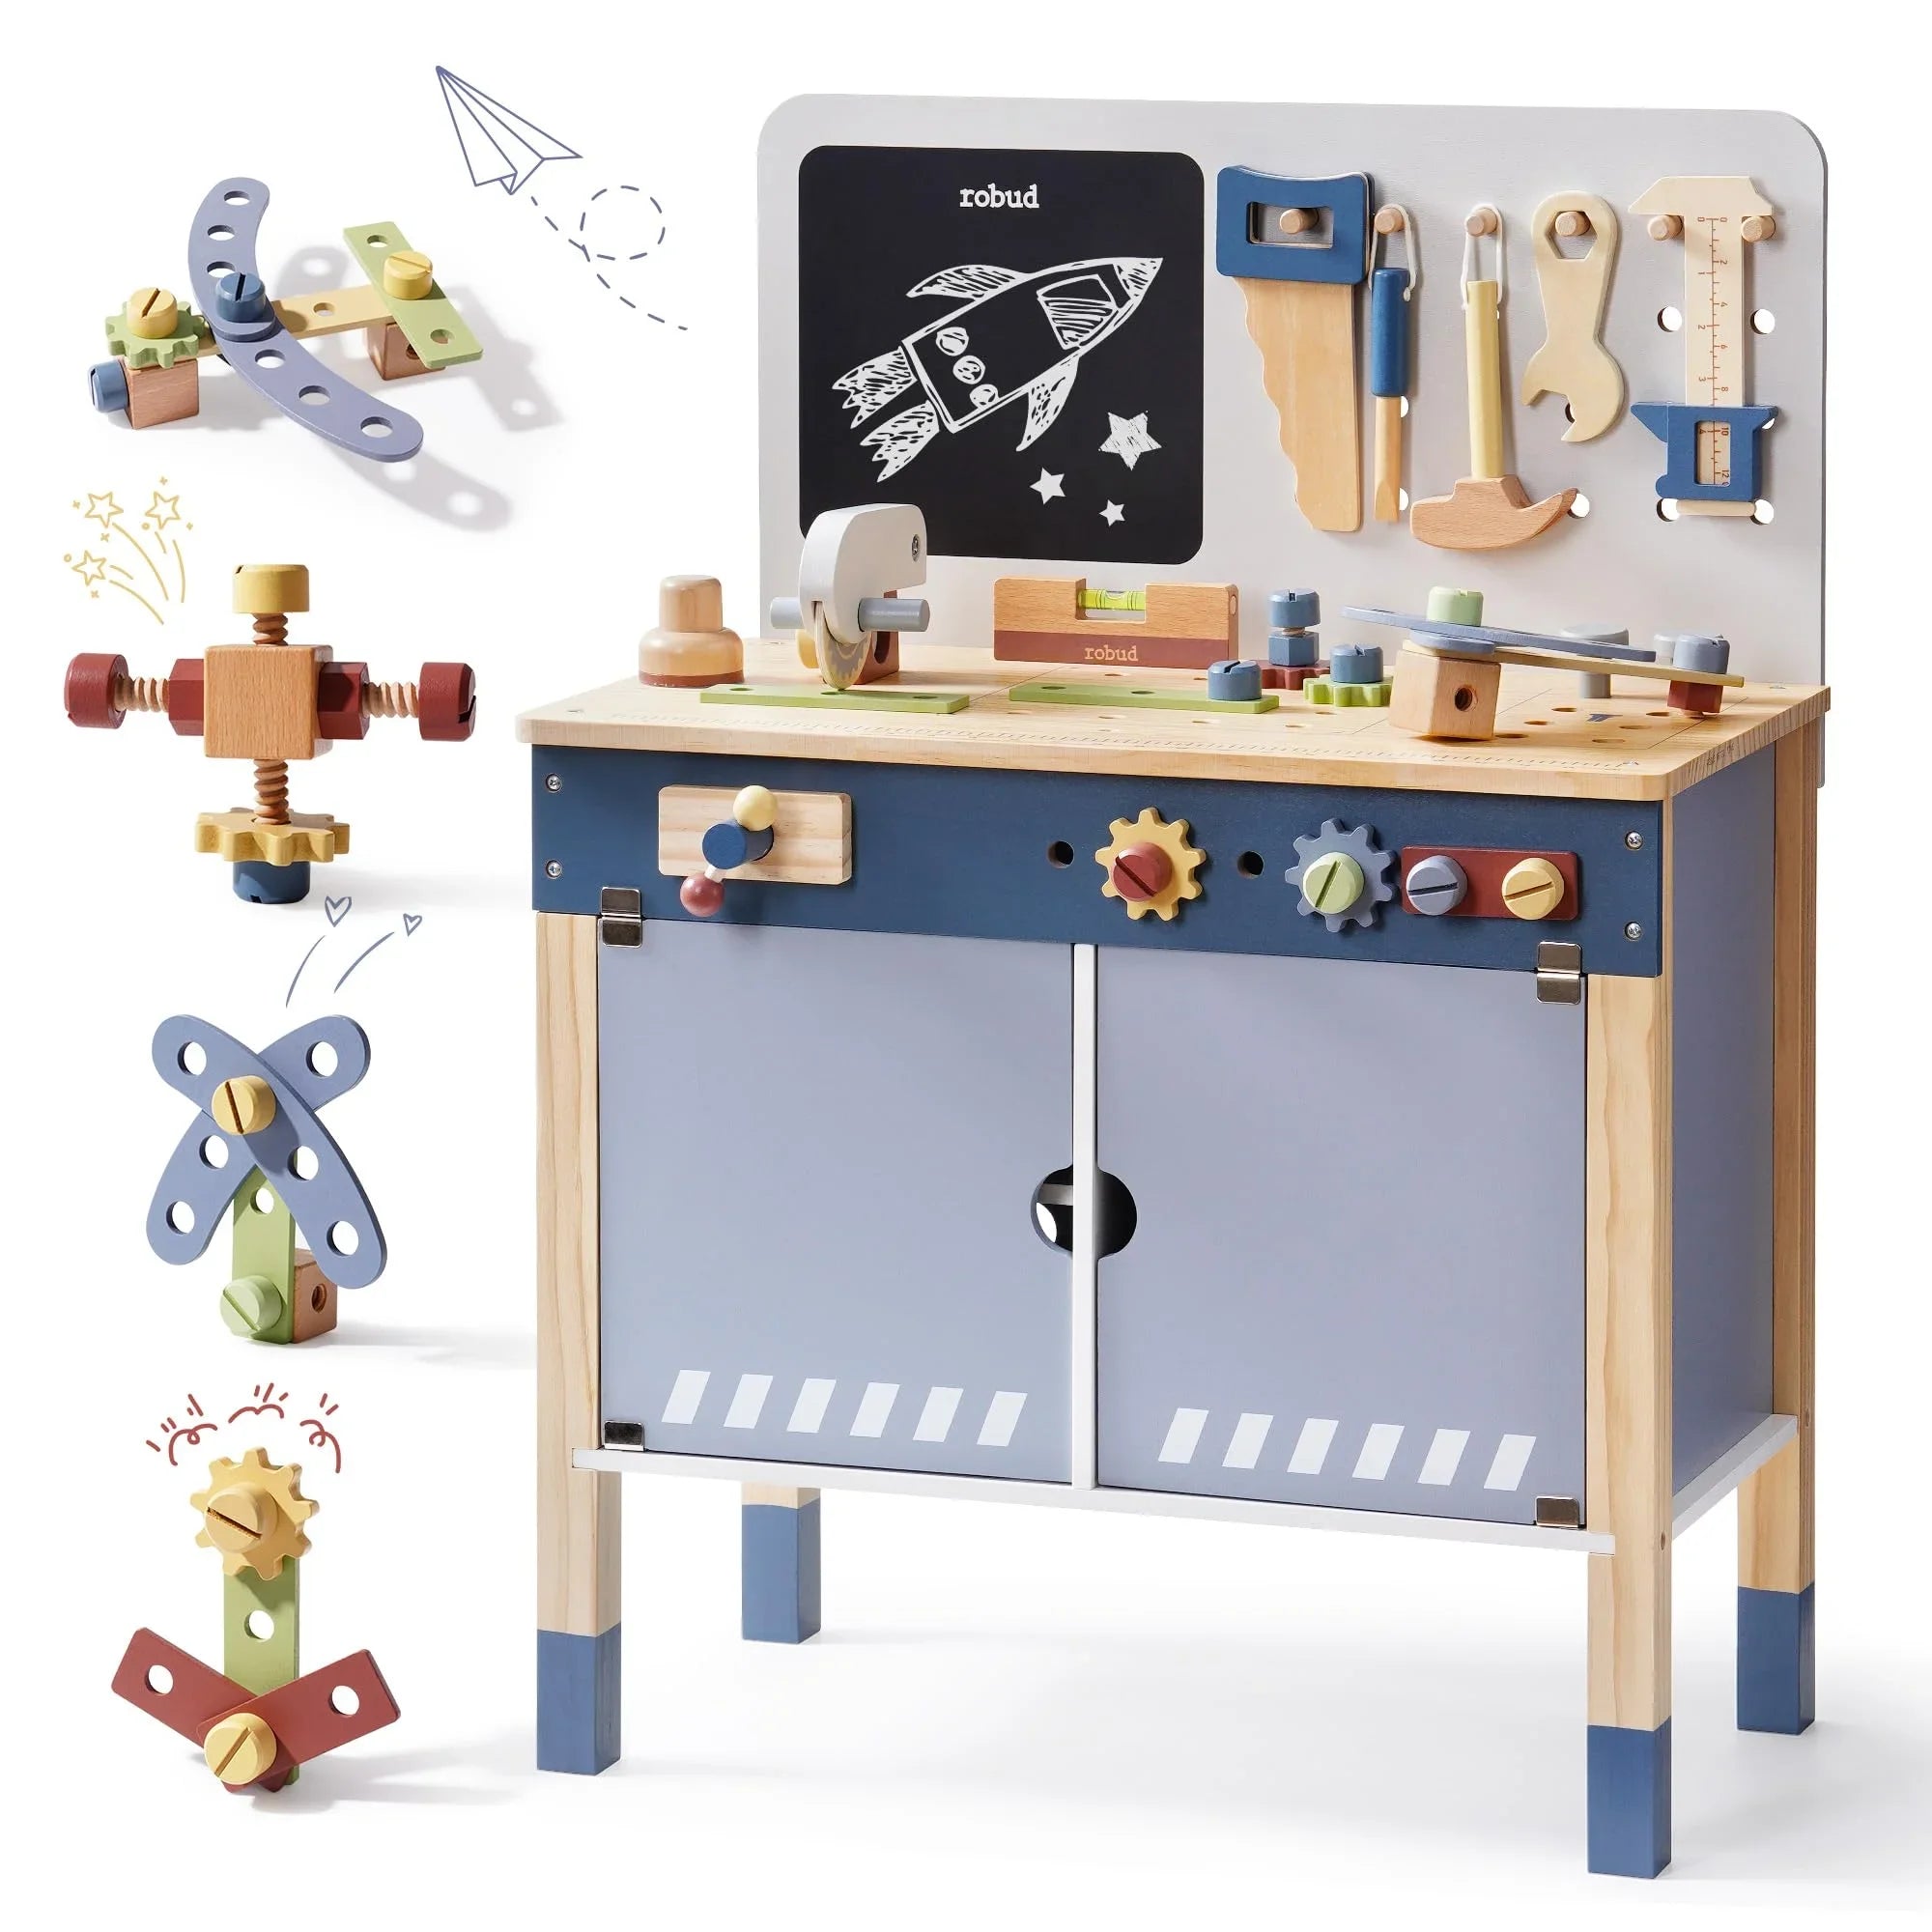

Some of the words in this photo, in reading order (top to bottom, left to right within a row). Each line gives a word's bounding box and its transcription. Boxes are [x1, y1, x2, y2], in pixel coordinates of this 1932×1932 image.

[959, 182, 1039, 208] robud
[1721, 427, 1729, 436] 10
[1721, 469, 1729, 478] 12
[1084, 644, 1138, 662] robud
